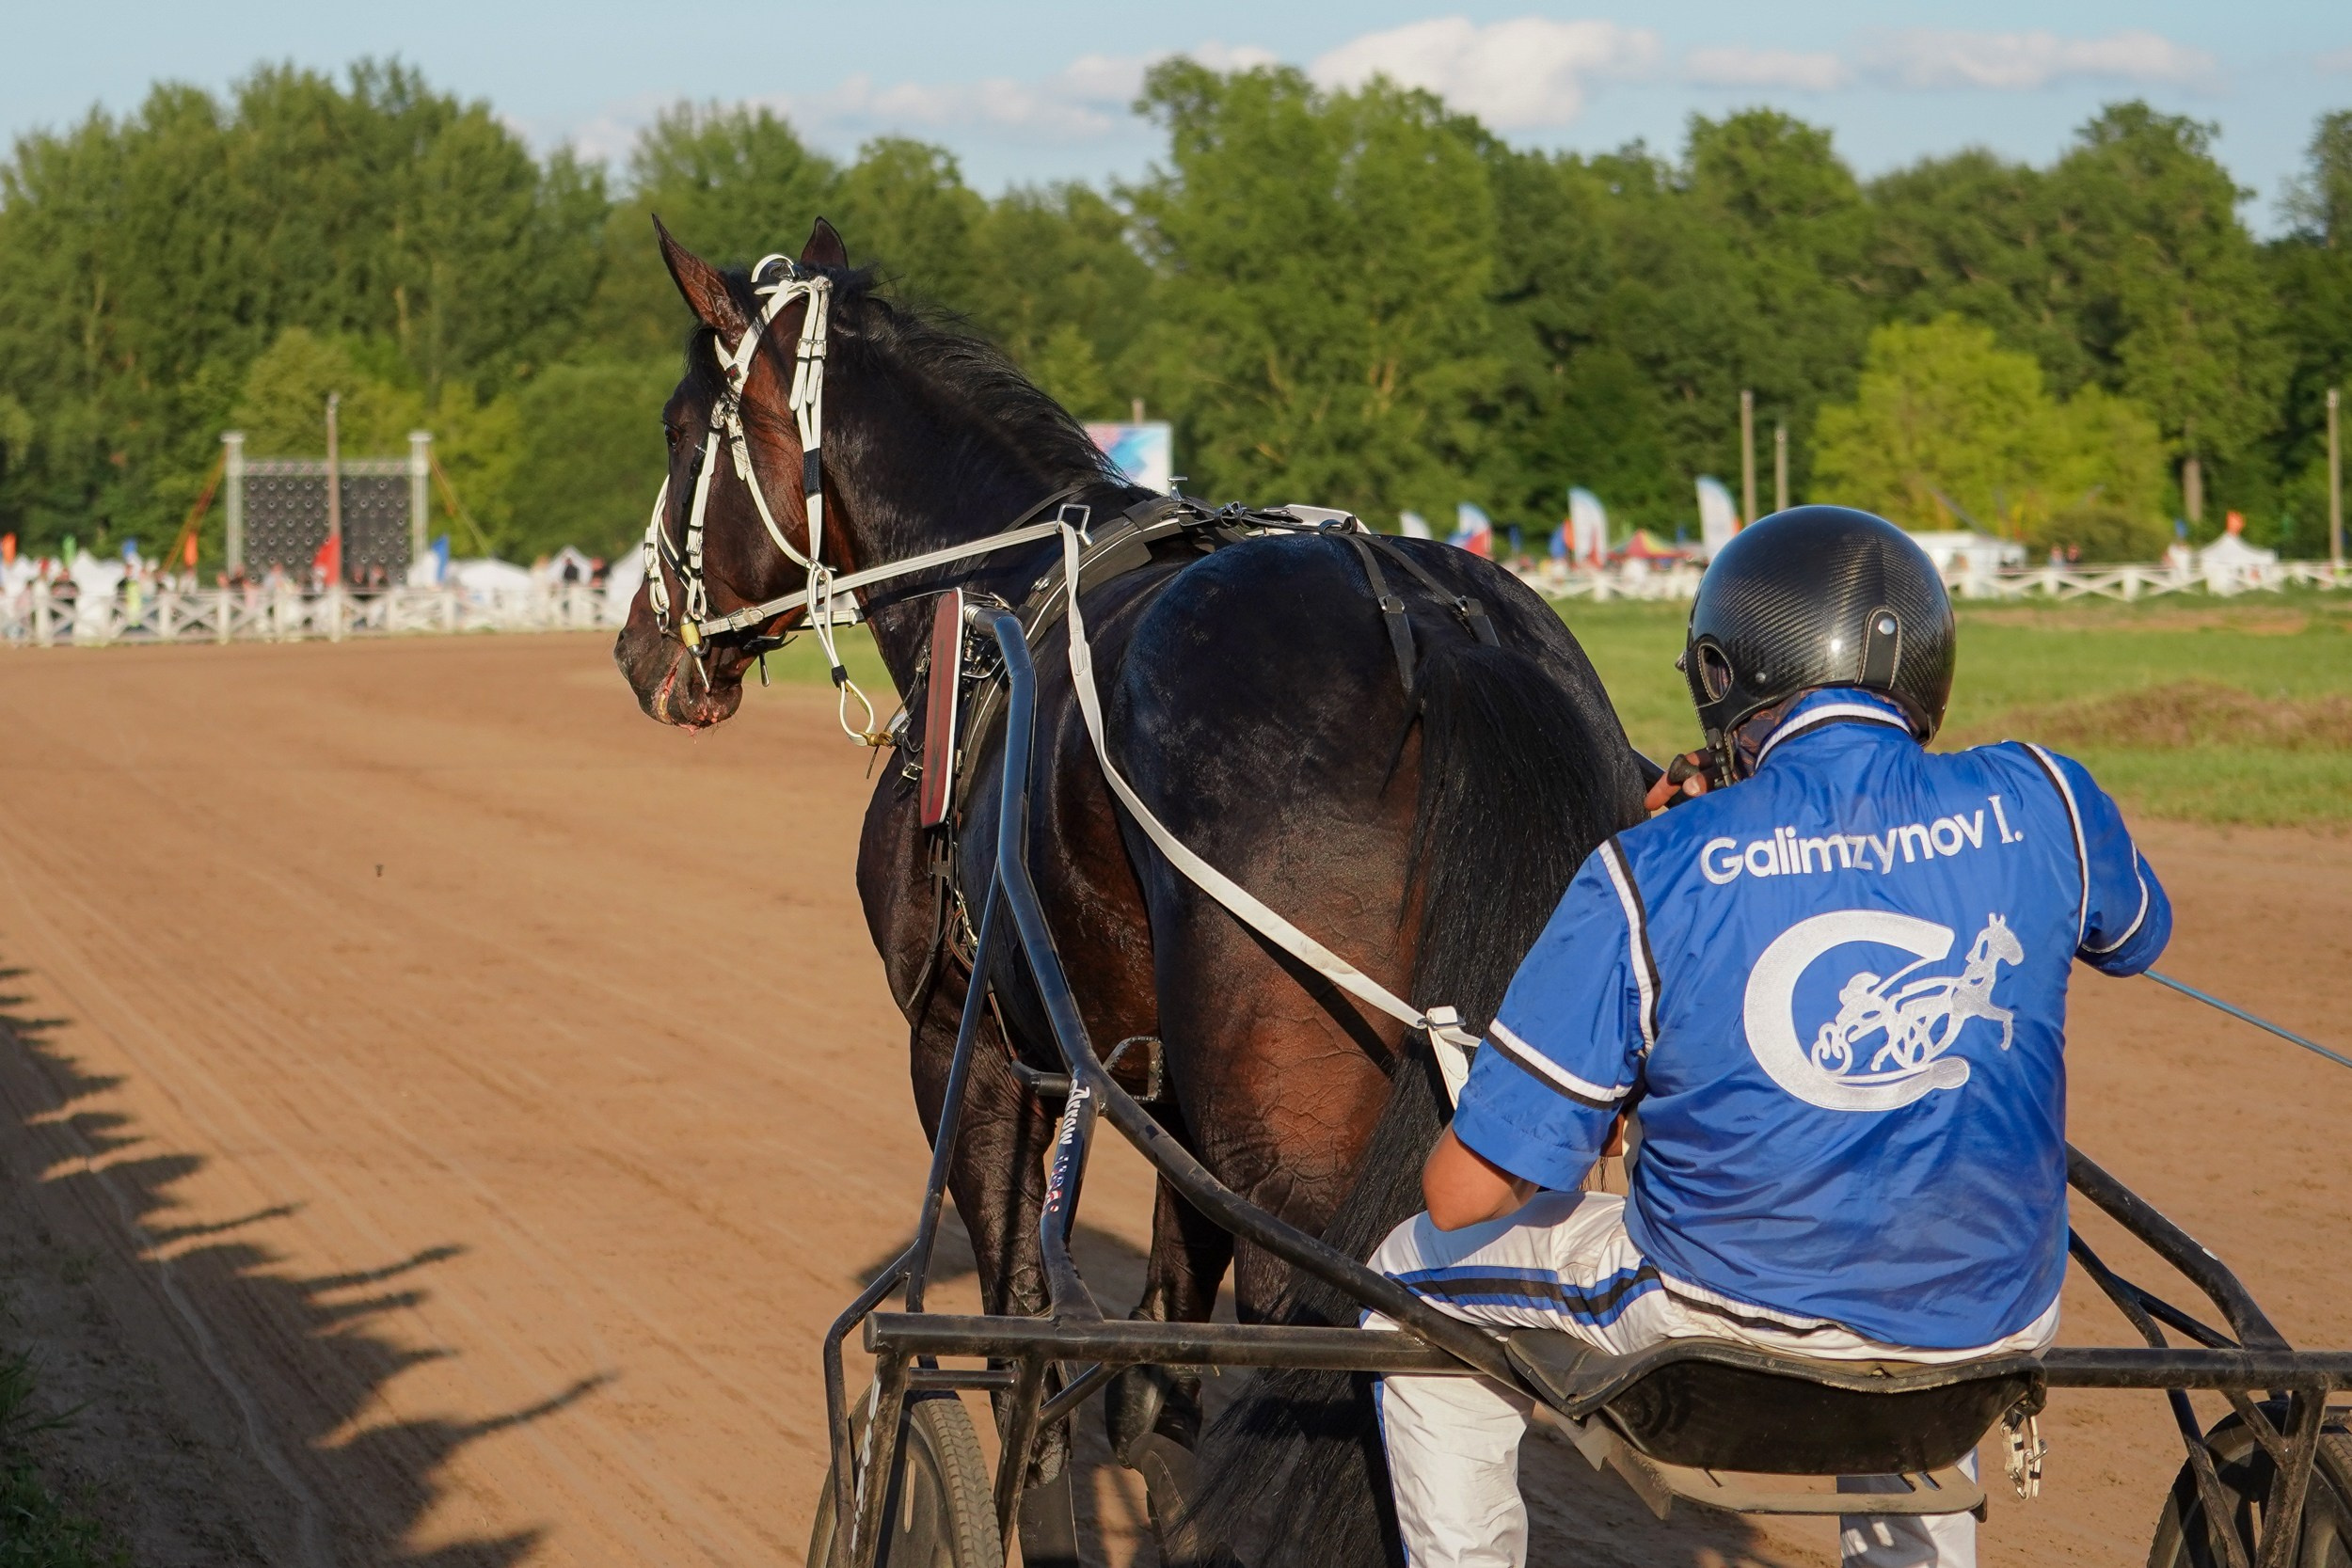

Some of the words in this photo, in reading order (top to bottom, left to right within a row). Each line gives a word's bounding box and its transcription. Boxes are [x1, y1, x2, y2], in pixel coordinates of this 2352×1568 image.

[1700, 809, 1984, 884] Galimzynov
[1988, 795, 2024, 844] I.
[1058, 1079, 1090, 1145] Arrow
